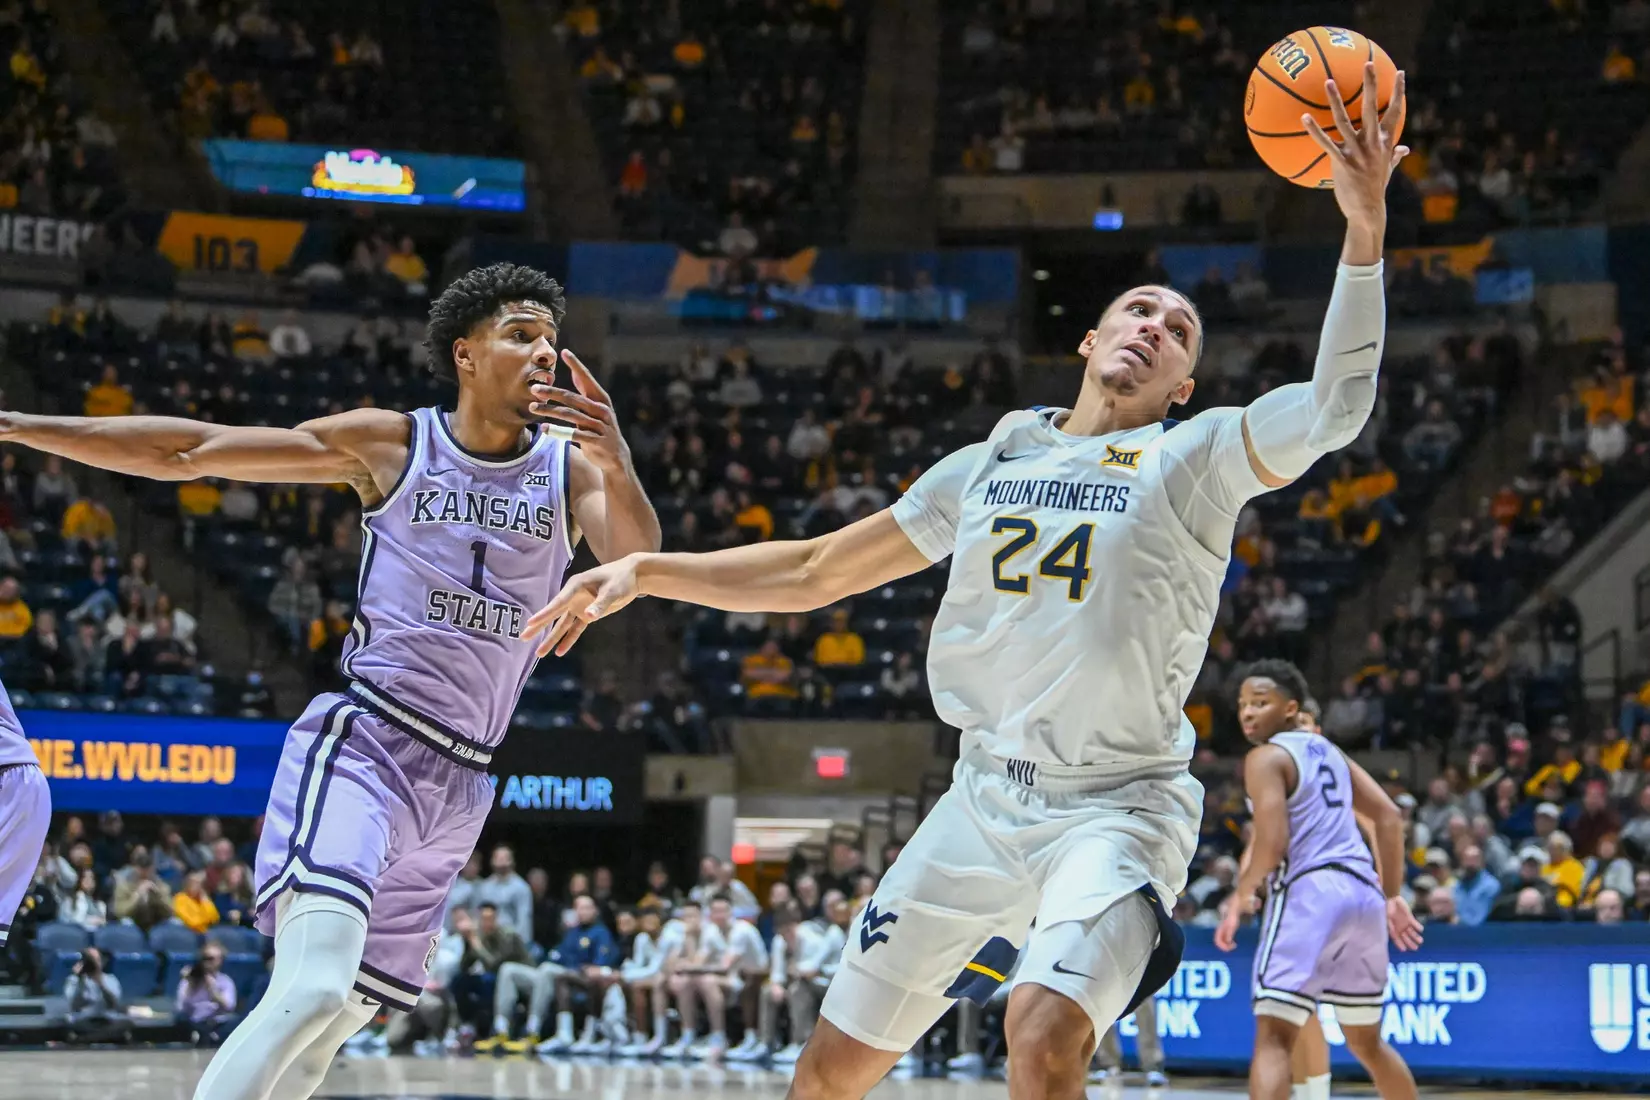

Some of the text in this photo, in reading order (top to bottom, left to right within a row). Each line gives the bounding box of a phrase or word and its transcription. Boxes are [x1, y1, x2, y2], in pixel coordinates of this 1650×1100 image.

[194, 233, 259, 274] 103
[1103, 447, 1137, 467] XII
[525, 473, 549, 487] XII
[984, 480, 1130, 513] MOUNTAINEERS
[410, 490, 556, 542] KANSAS
[471, 541, 488, 596] 1
[990, 516, 1097, 602] 24
[427, 589, 523, 639] STATE
[30, 738, 236, 785] NE.WVU.EDU
[501, 775, 613, 811] ARTHUR
[1319, 765, 1345, 808] 2
[1384, 962, 1487, 1003] NITED
[1380, 1003, 1452, 1045] ANK
